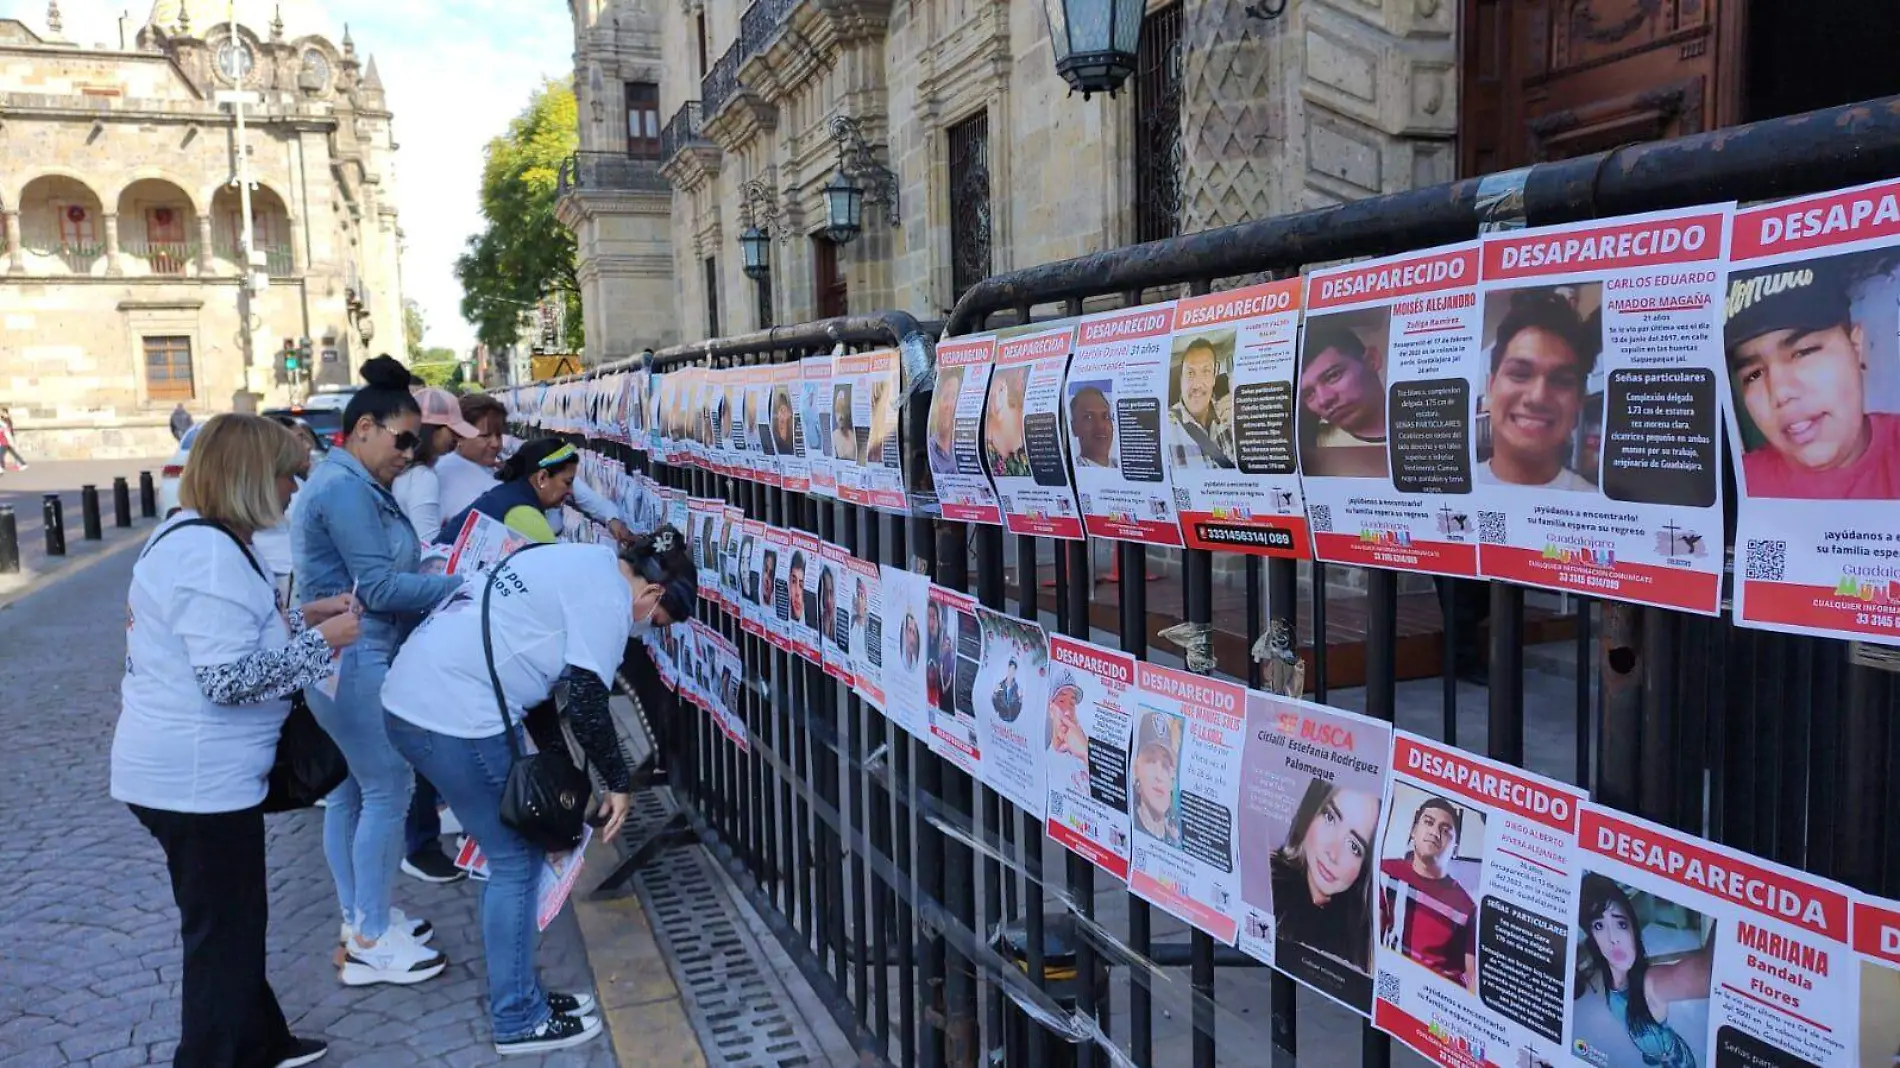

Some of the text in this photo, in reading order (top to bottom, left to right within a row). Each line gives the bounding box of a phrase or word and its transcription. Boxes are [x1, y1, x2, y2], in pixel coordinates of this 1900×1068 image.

[1760, 194, 1900, 246] DESAPA
[1501, 224, 1706, 271] DESAPARECIDO
[1322, 257, 1464, 300] DESAPARECIDO
[1607, 271, 1717, 291] CARLOS EDUARDO
[1182, 291, 1290, 325] DESAPARECIDO
[1393, 292, 1477, 317] MOISÉS ALEJANDRO
[1607, 292, 1712, 311] AMADOR MAGAÑA
[1086, 314, 1165, 340] DESAPARECIDO
[1643, 314, 1671, 323] 21 años
[1615, 373, 1707, 385] Señas particulares
[1667, 393, 1695, 404] delgada
[1539, 517, 1566, 528] familia
[1567, 522, 1596, 532] espera
[1598, 525, 1609, 533] su
[1610, 526, 1646, 537] regreso
[1583, 510, 1639, 522] encontrarlo!
[1269, 532, 1290, 545] 089
[1546, 531, 1616, 549] Guadalajara
[1824, 530, 1882, 542] ¡ayúdanos
[1816, 544, 1900, 559] su familia espe
[505, 572, 531, 594] por
[1812, 599, 1862, 611] CUALQUIER
[1056, 647, 1128, 681] DESAPARECIDO
[1142, 671, 1236, 712] DESAPARECIDO
[1300, 717, 1354, 752] BUSCA
[1285, 756, 1336, 784] Palomeque
[1408, 747, 1568, 821] DESAPARECIDO
[1504, 820, 1530, 836] DIEGO
[1597, 825, 1828, 931] DESAPARECIDA
[1511, 908, 1568, 937] PARTICULARES
[1737, 920, 1829, 978] MARIANA
[1746, 954, 1813, 992] Bandala
[1750, 977, 1800, 1008] Flores
